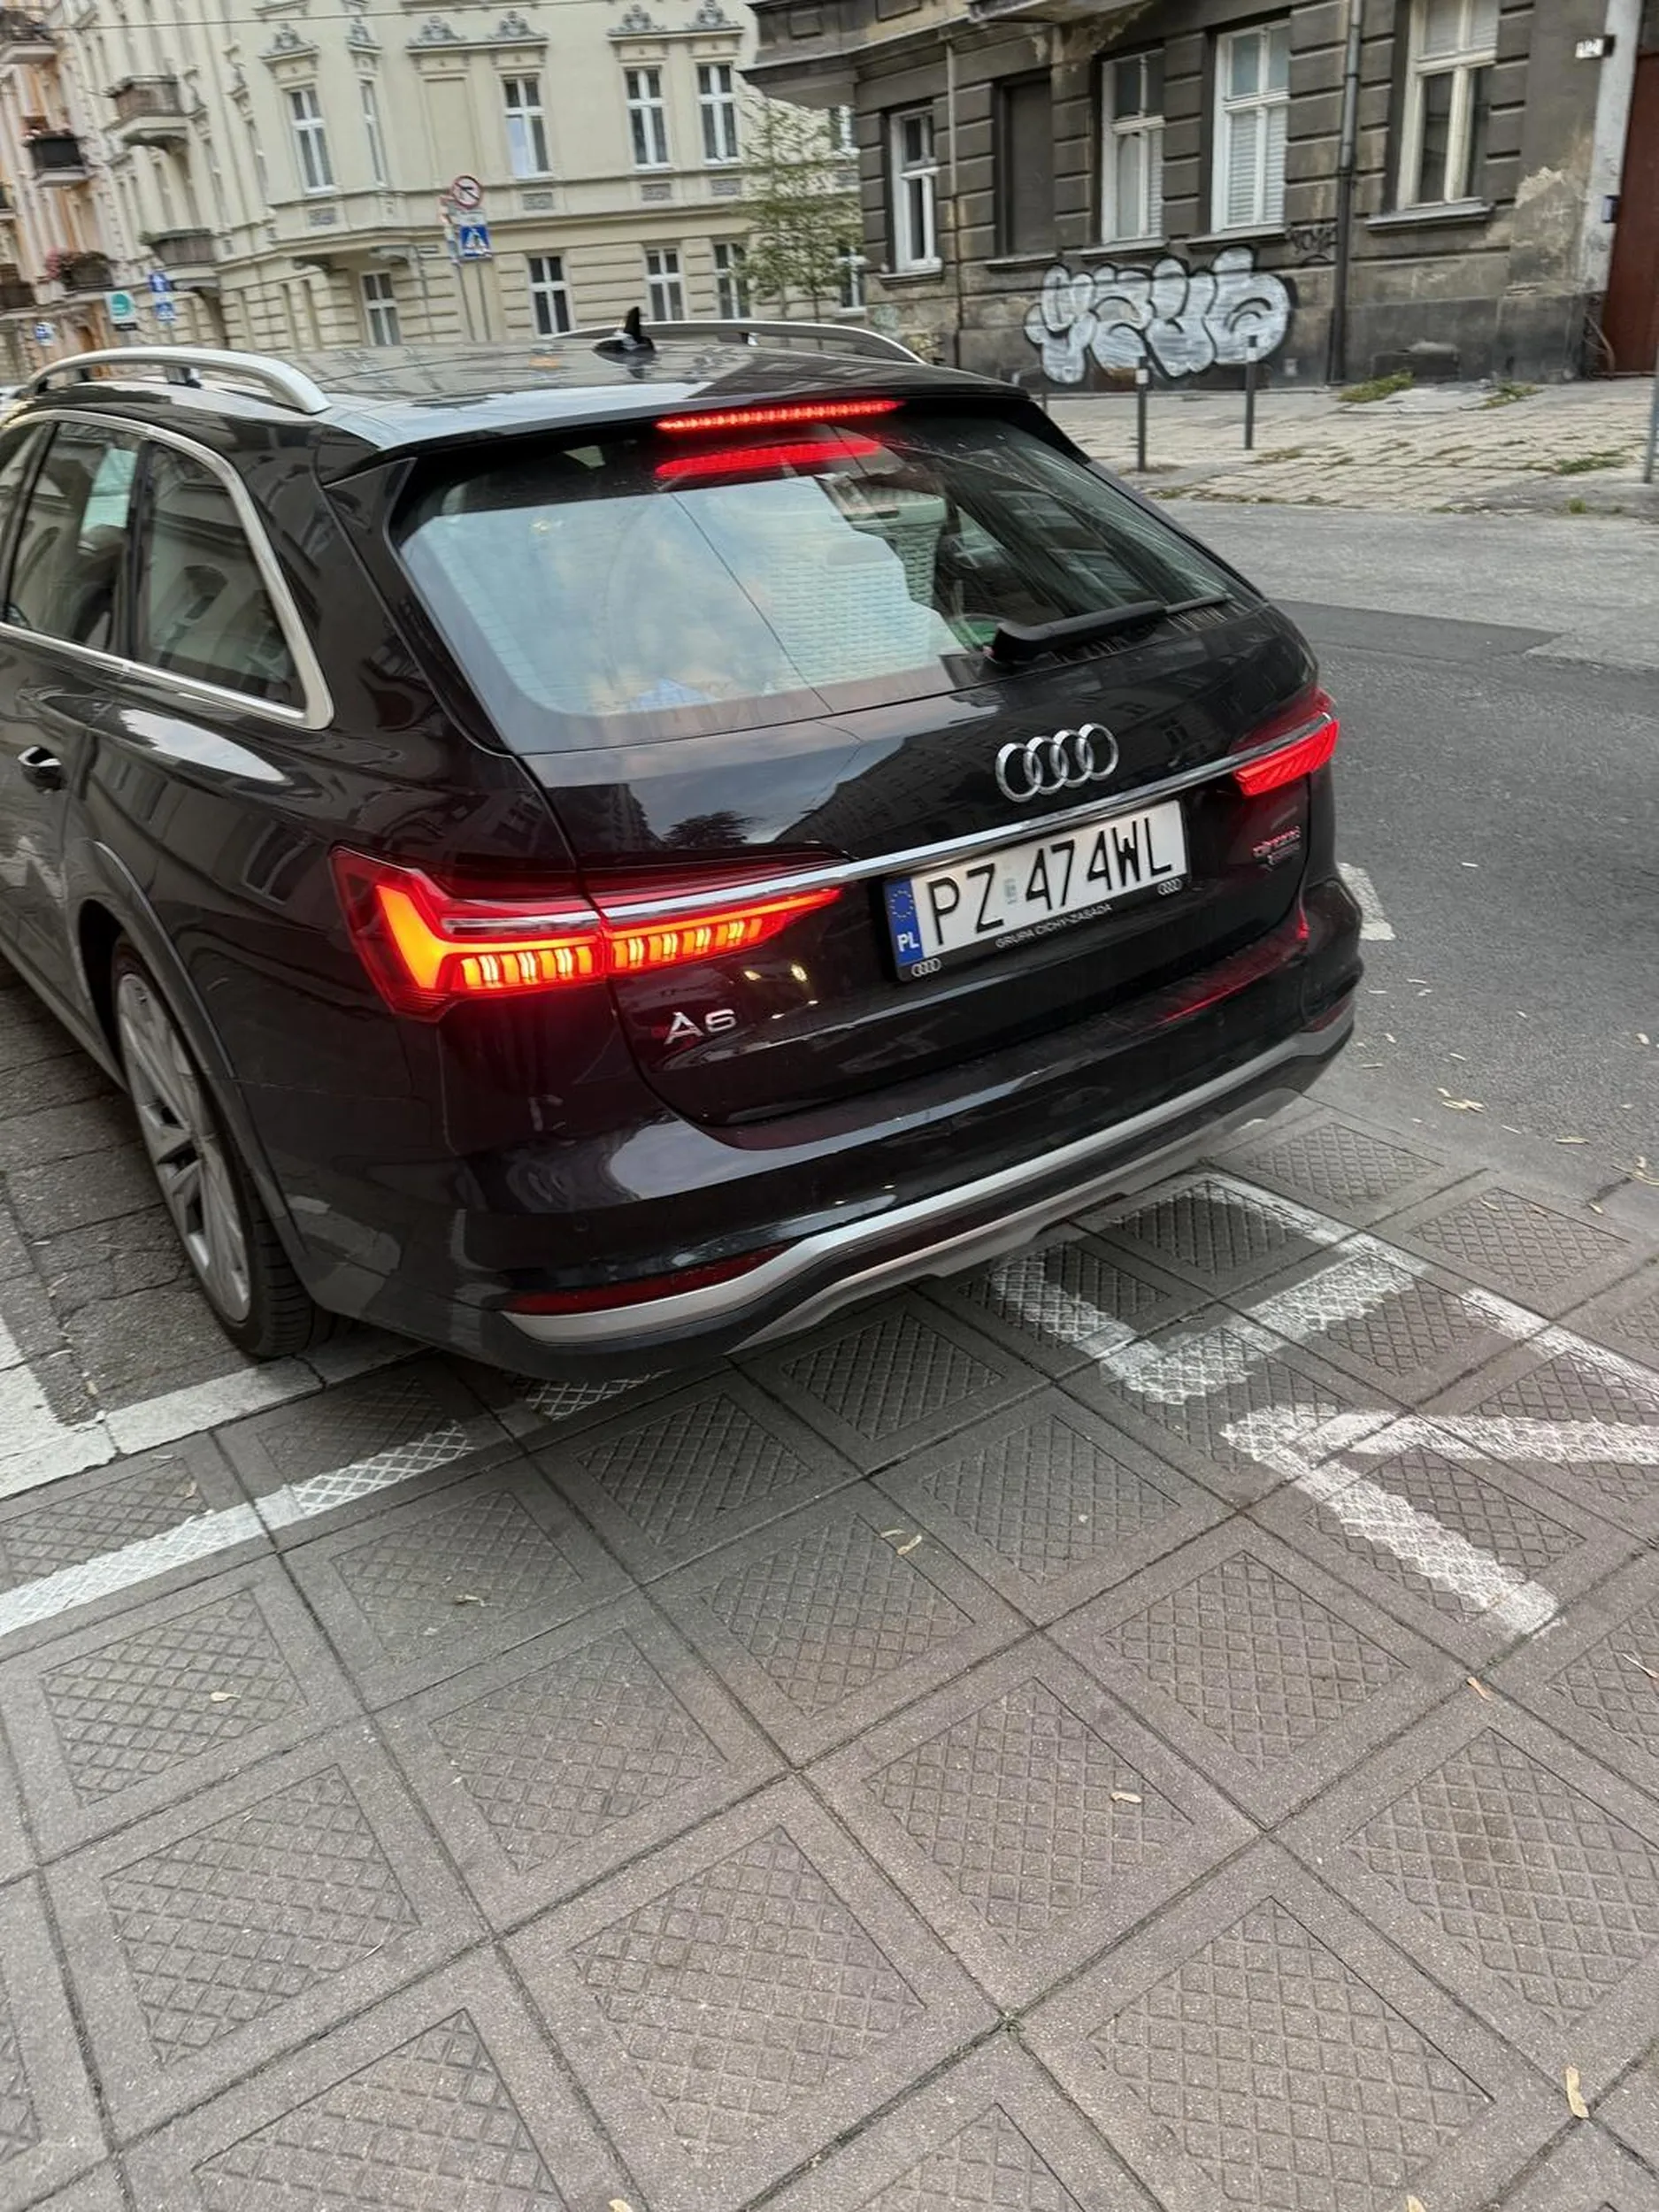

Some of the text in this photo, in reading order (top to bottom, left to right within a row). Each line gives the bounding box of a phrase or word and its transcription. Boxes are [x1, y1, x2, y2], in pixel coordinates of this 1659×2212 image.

[926, 817, 1172, 946] PZ 474WL
[896, 931, 920, 953] PL
[663, 1008, 737, 1046] A6
